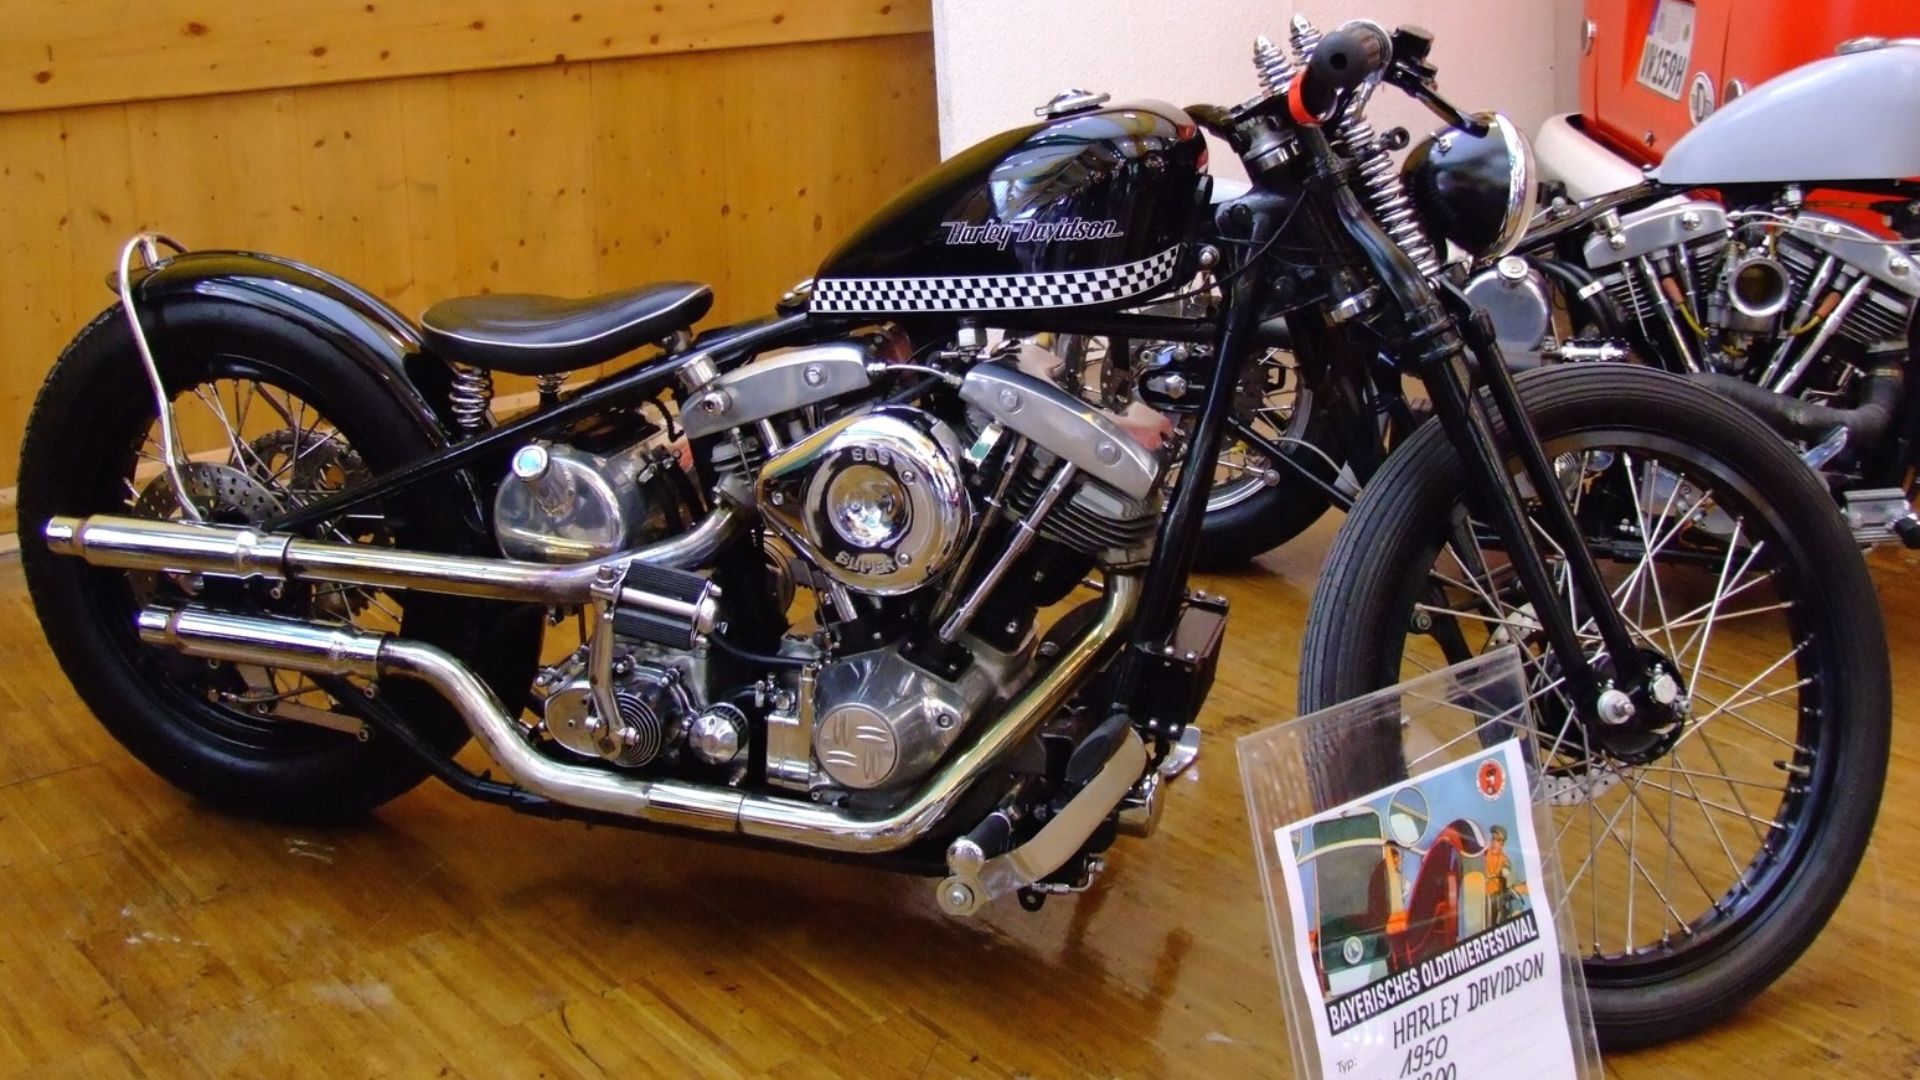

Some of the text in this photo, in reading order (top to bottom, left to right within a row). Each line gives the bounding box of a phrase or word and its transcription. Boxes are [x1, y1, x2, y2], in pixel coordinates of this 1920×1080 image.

[835, 551, 898, 575] SUPER
[1328, 915, 1538, 1031] BAYERISCHES OLDTIMERFESTIVAL
[1393, 952, 1544, 1050] HARLEY DAVIDSON
[1336, 1057, 1358, 1074] Typ:
[1400, 1034, 1448, 1079] 1950
